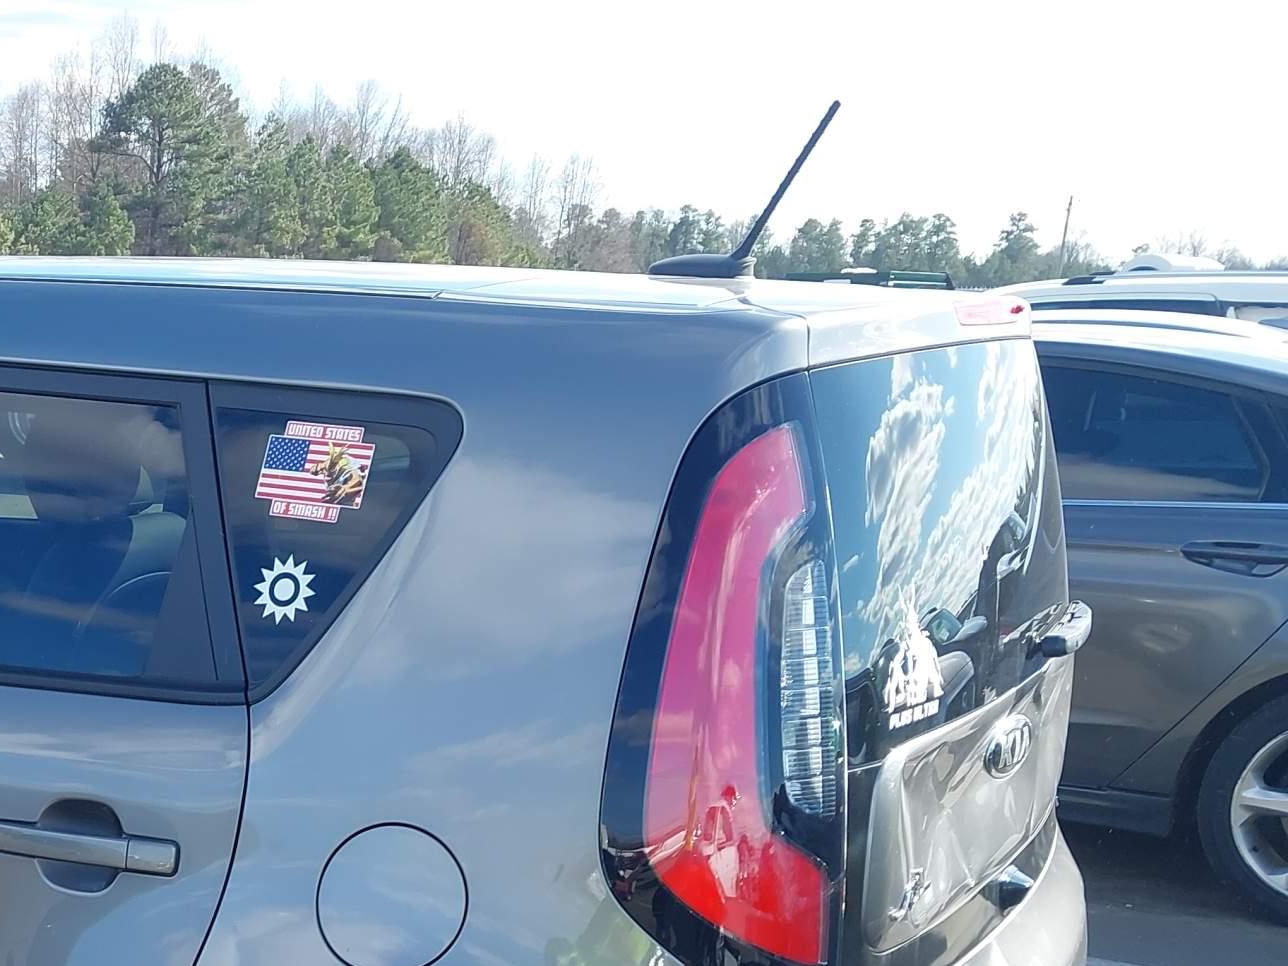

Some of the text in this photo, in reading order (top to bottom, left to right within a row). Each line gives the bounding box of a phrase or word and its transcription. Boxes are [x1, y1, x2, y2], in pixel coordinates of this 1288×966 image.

[288, 423, 361, 441] UNITED STATES
[273, 501, 287, 514] OF
[288, 503, 326, 519] SMASH
[889, 708, 913, 730] PLUS
[998, 725, 1030, 769] KIA
